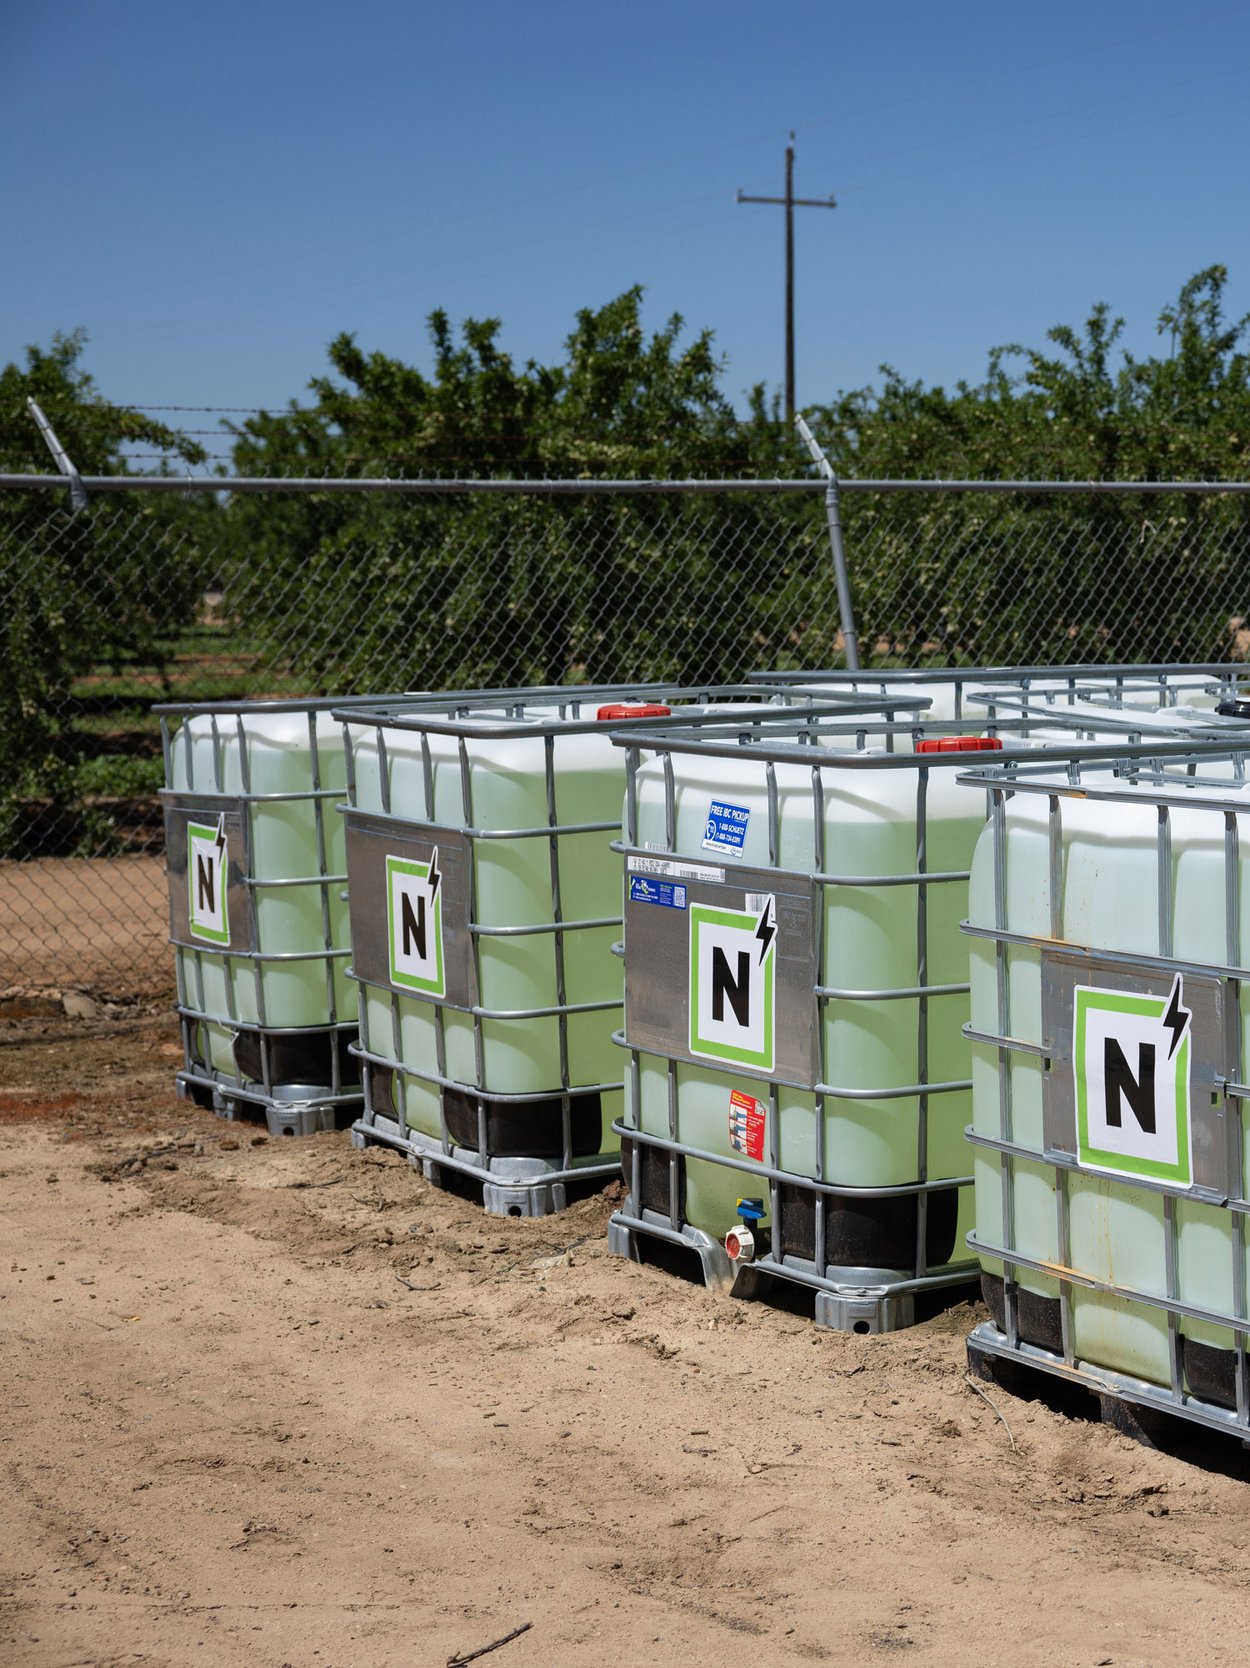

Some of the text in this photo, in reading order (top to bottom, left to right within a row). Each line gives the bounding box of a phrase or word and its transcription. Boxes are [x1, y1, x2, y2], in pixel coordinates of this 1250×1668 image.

[711, 805, 750, 822] FREE IBC PICKUP
[197, 854, 215, 914] N
[401, 892, 427, 961] N
[712, 946, 750, 1028] N
[1104, 1037, 1157, 1135] N
